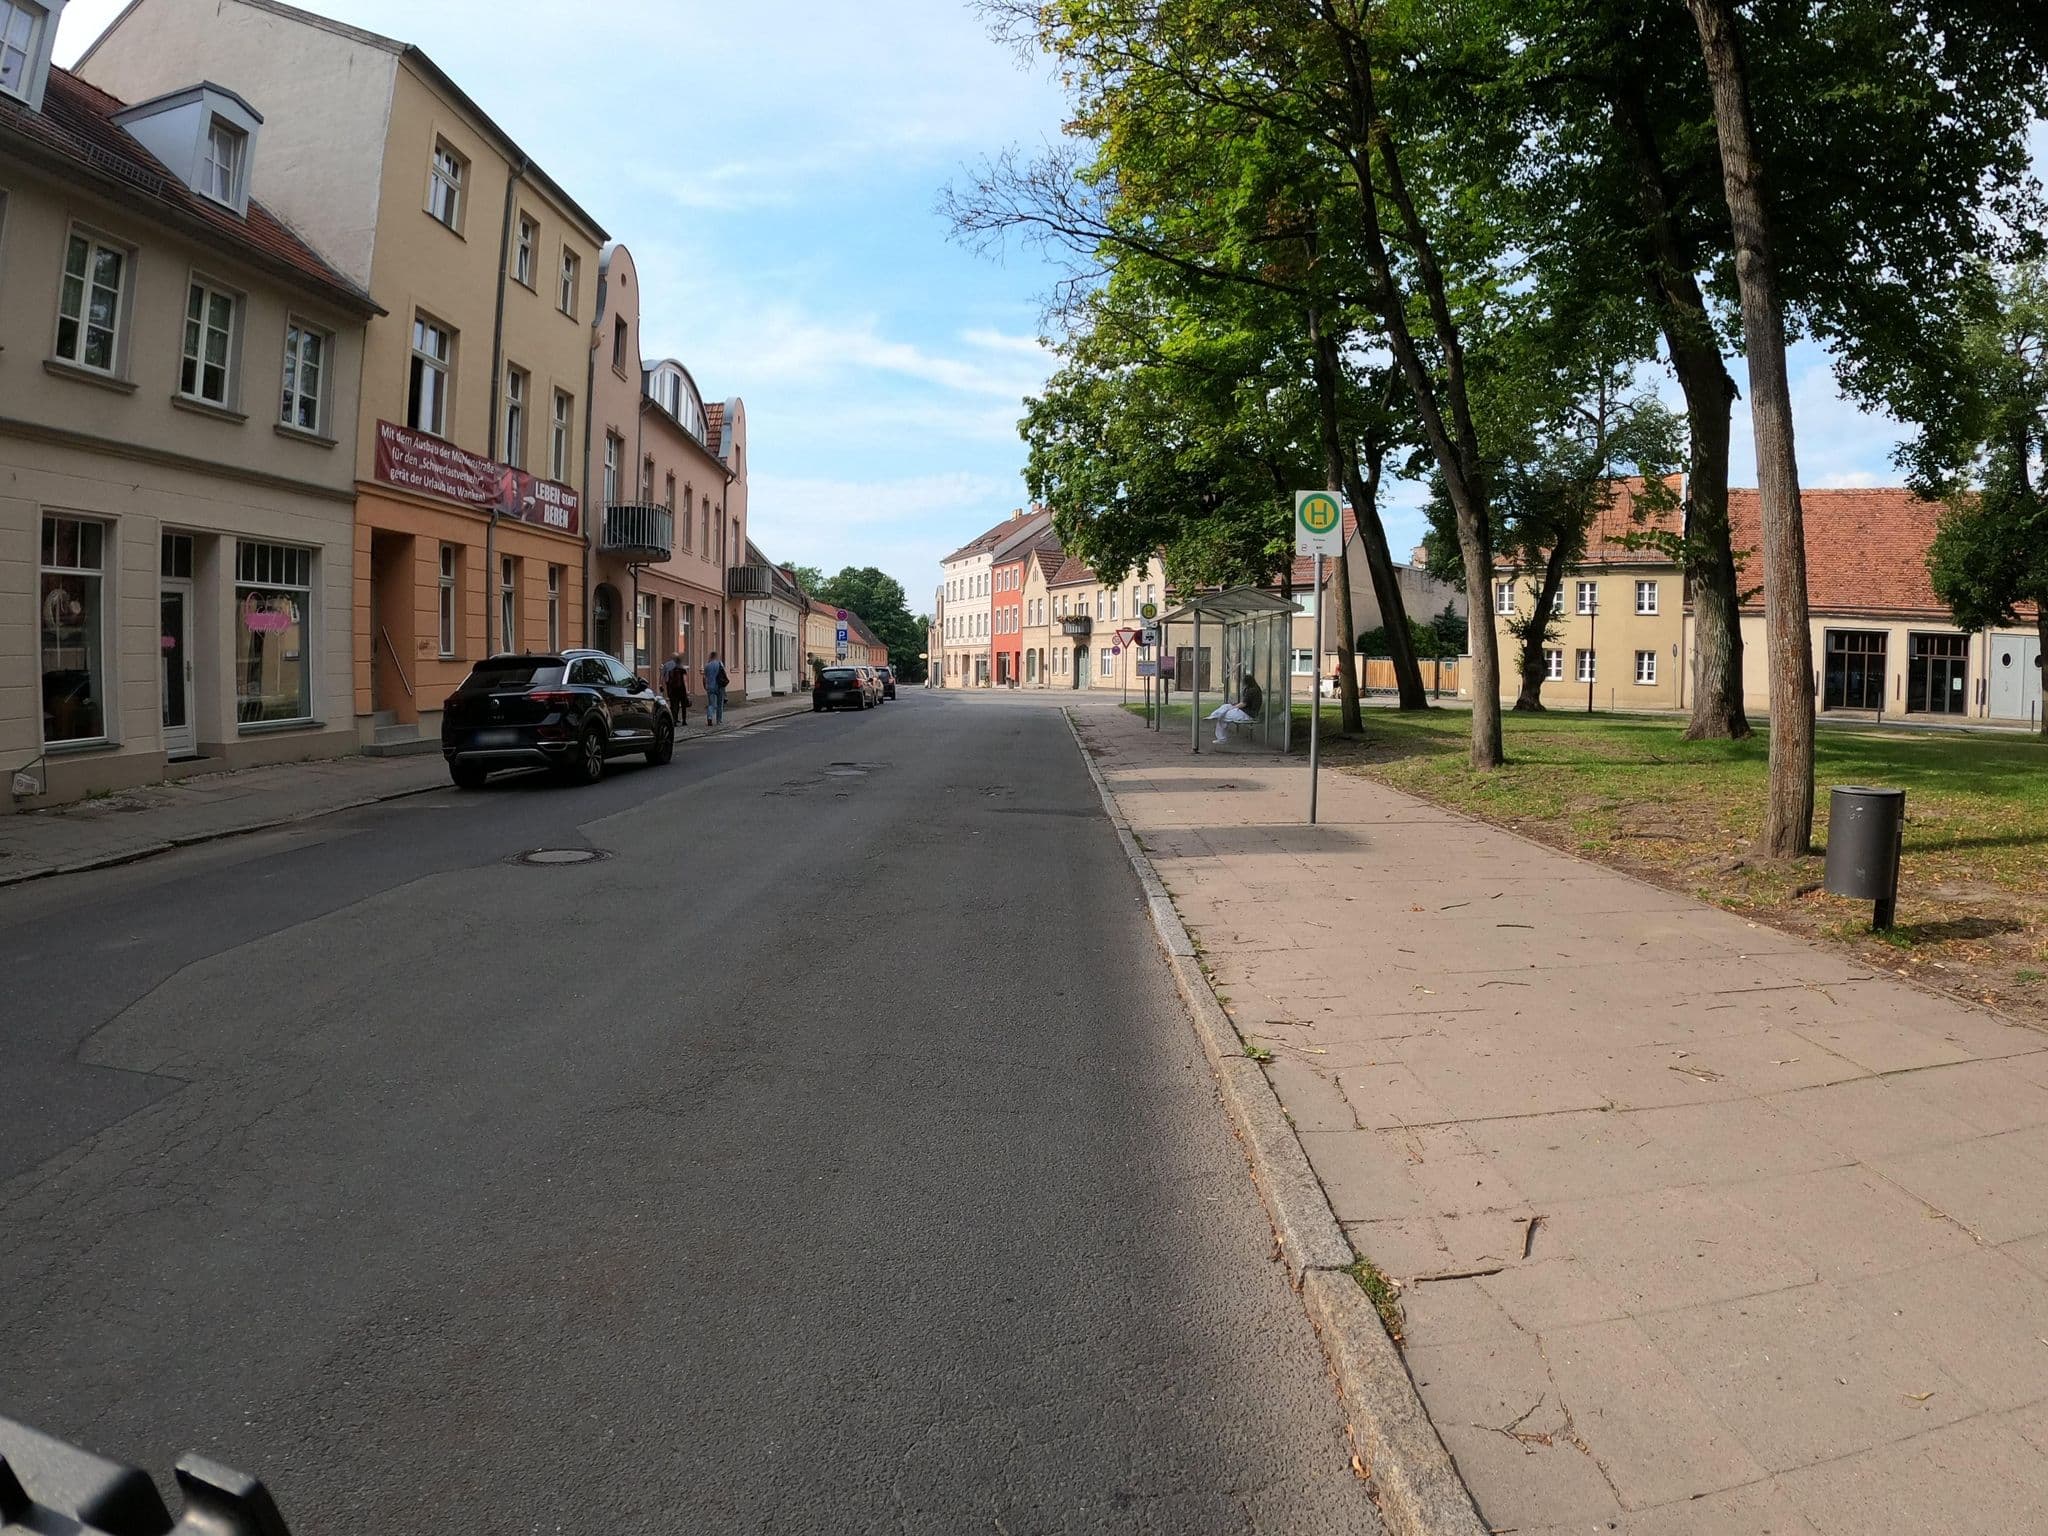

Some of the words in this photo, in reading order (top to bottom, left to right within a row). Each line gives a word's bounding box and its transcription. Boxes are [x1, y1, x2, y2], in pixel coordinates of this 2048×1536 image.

[381, 425, 395, 440] Mit
[396, 430, 412, 447] dem
[413, 437, 439, 455] Ausbau
[439, 446, 450, 459] der
[392, 447, 403, 460] für
[404, 454, 418, 466] den
[390, 468, 409, 481] gerät
[410, 474, 423, 485] der
[423, 475, 446, 492] Urlaub
[446, 484, 457, 495] ins
[535, 480, 560, 505] LEBEN
[561, 492, 577, 508] STATT
[1311, 502, 1328, 525] H
[838, 630, 846, 640] P
